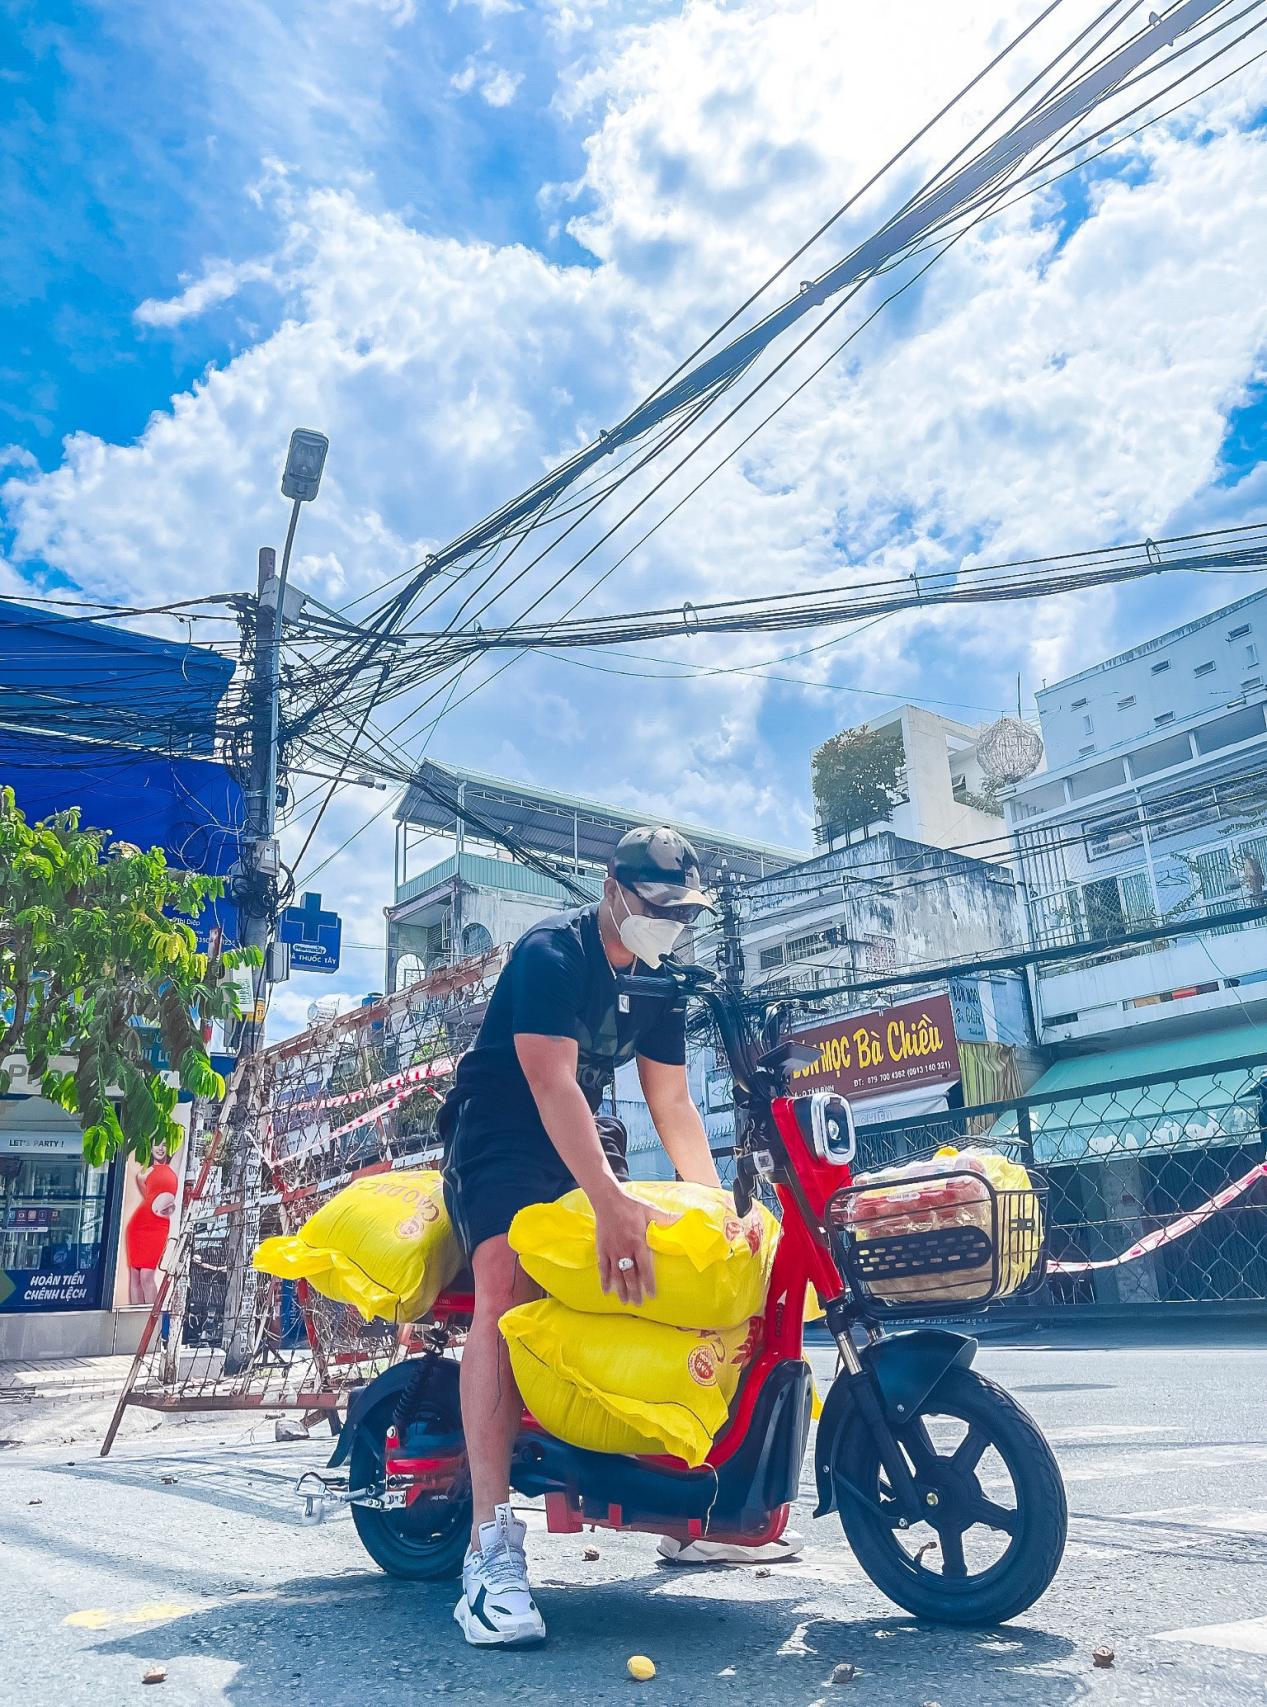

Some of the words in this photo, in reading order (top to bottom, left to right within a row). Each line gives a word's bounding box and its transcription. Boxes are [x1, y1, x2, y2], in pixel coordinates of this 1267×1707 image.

[299, 953, 322, 963] THUỐC
[819, 1035, 852, 1079] MỌC
[853, 1027, 885, 1070] Bà
[886, 1013, 944, 1063] Chiều
[30, 1272, 60, 1287] HOÀN
[62, 1270, 86, 1285] TIỀN
[24, 1286, 60, 1300] CHÊNH
[60, 1286, 88, 1302] LỆCH
